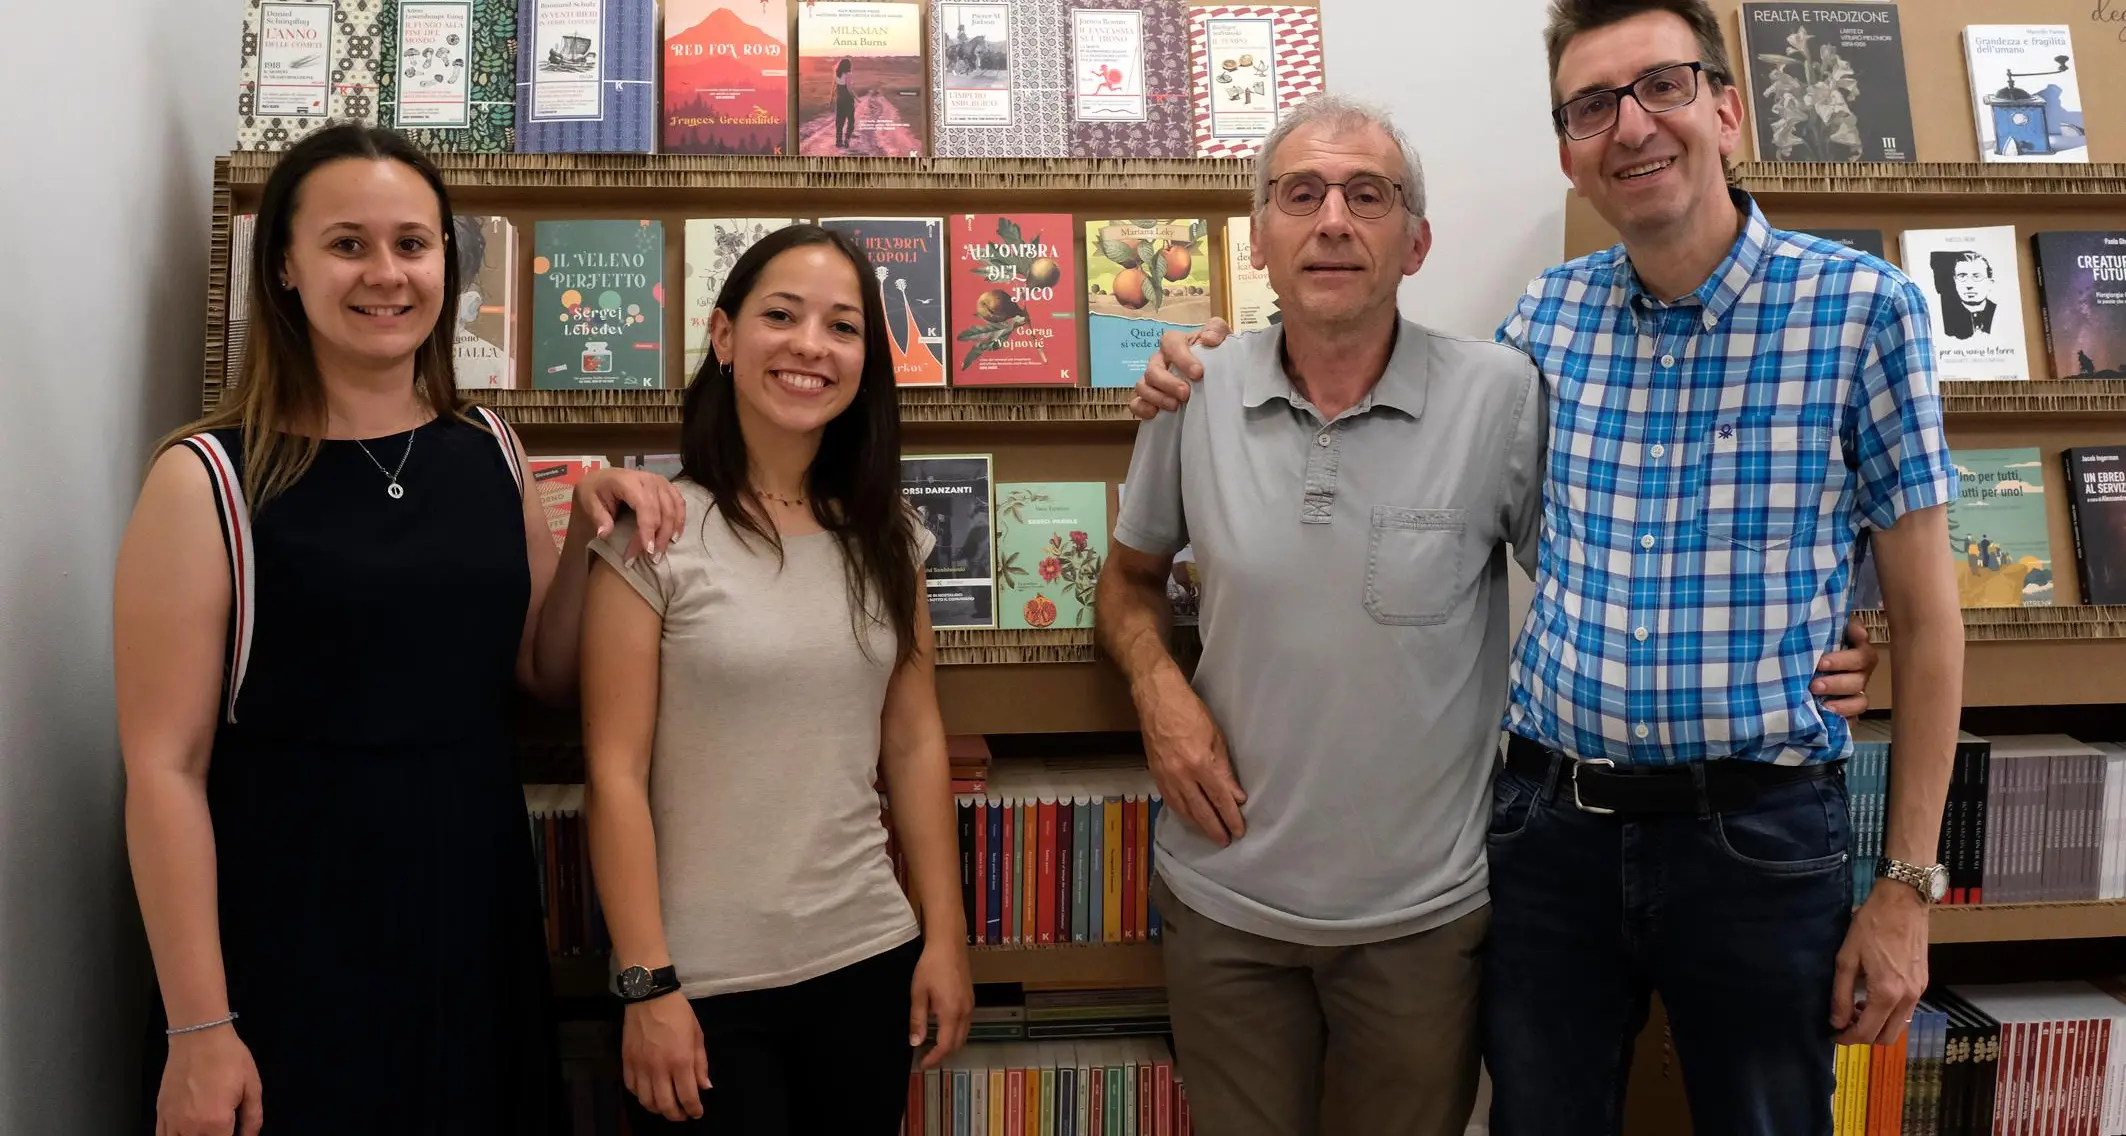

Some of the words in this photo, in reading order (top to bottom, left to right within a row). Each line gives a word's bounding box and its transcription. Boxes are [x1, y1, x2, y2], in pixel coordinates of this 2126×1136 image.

[1802, 12, 1811, 22] E
[1813, 10, 1890, 24] TRADIZIONE
[266, 28, 317, 40] L'ANNO
[830, 26, 888, 35] MILKMAN
[833, 38, 857, 46] Anna
[860, 38, 887, 46] Burns
[1976, 36, 2020, 46] Grandezza
[671, 44, 703, 56] RED
[709, 44, 740, 58] FOX
[744, 44, 780, 56] ROAD
[1976, 46, 2025, 54] dell'umano
[669, 116, 714, 126] Frances
[774, 147, 782, 155] K
[1121, 228, 1154, 236] Mariana
[1156, 228, 1175, 236] Leky
[961, 244, 1060, 260] ALL'OMBRA
[1237, 243, 1250, 252] L'e
[553, 253, 570, 268] IL
[574, 250, 645, 268] VELENO
[985, 264, 1026, 282] DEL
[2093, 268, 2126, 281] FUTU
[550, 273, 646, 290] PERFETTO
[1010, 286, 1054, 302] FICO
[574, 307, 622, 320] Sergej
[564, 322, 630, 336] Lebedev
[928, 328, 936, 336] K
[1016, 326, 1054, 338] Goran
[1130, 328, 1155, 338] Quel
[992, 337, 1044, 350] Vojnović
[1120, 340, 1130, 348] si
[1131, 340, 1152, 348] vede
[1154, 340, 1162, 348] d
[1060, 369, 1070, 379] K
[490, 376, 497, 384] K
[643, 378, 652, 387] K
[1978, 473, 1994, 484] per
[1997, 470, 2022, 482] tutti,
[2084, 472, 2096, 482] UN
[2098, 471, 2126, 482] EBREO
[902, 487, 924, 496] ORSI
[925, 486, 972, 495] DANZANTI
[1962, 487, 1978, 498] utti
[1982, 488, 1998, 500] per
[2000, 486, 2024, 497] uno!
[2086, 484, 2096, 494] AL
[974, 784, 982, 792] K
[1042, 932, 1050, 941] K
[1076, 932, 1083, 942] K
[1125, 930, 1132, 938] K
[1150, 928, 1158, 936] K
[977, 934, 984, 944] K
[1003, 936, 1010, 944] K
[1014, 934, 1020, 943] K
[1025, 934, 1032, 943] K
[572, 946, 582, 956] K
